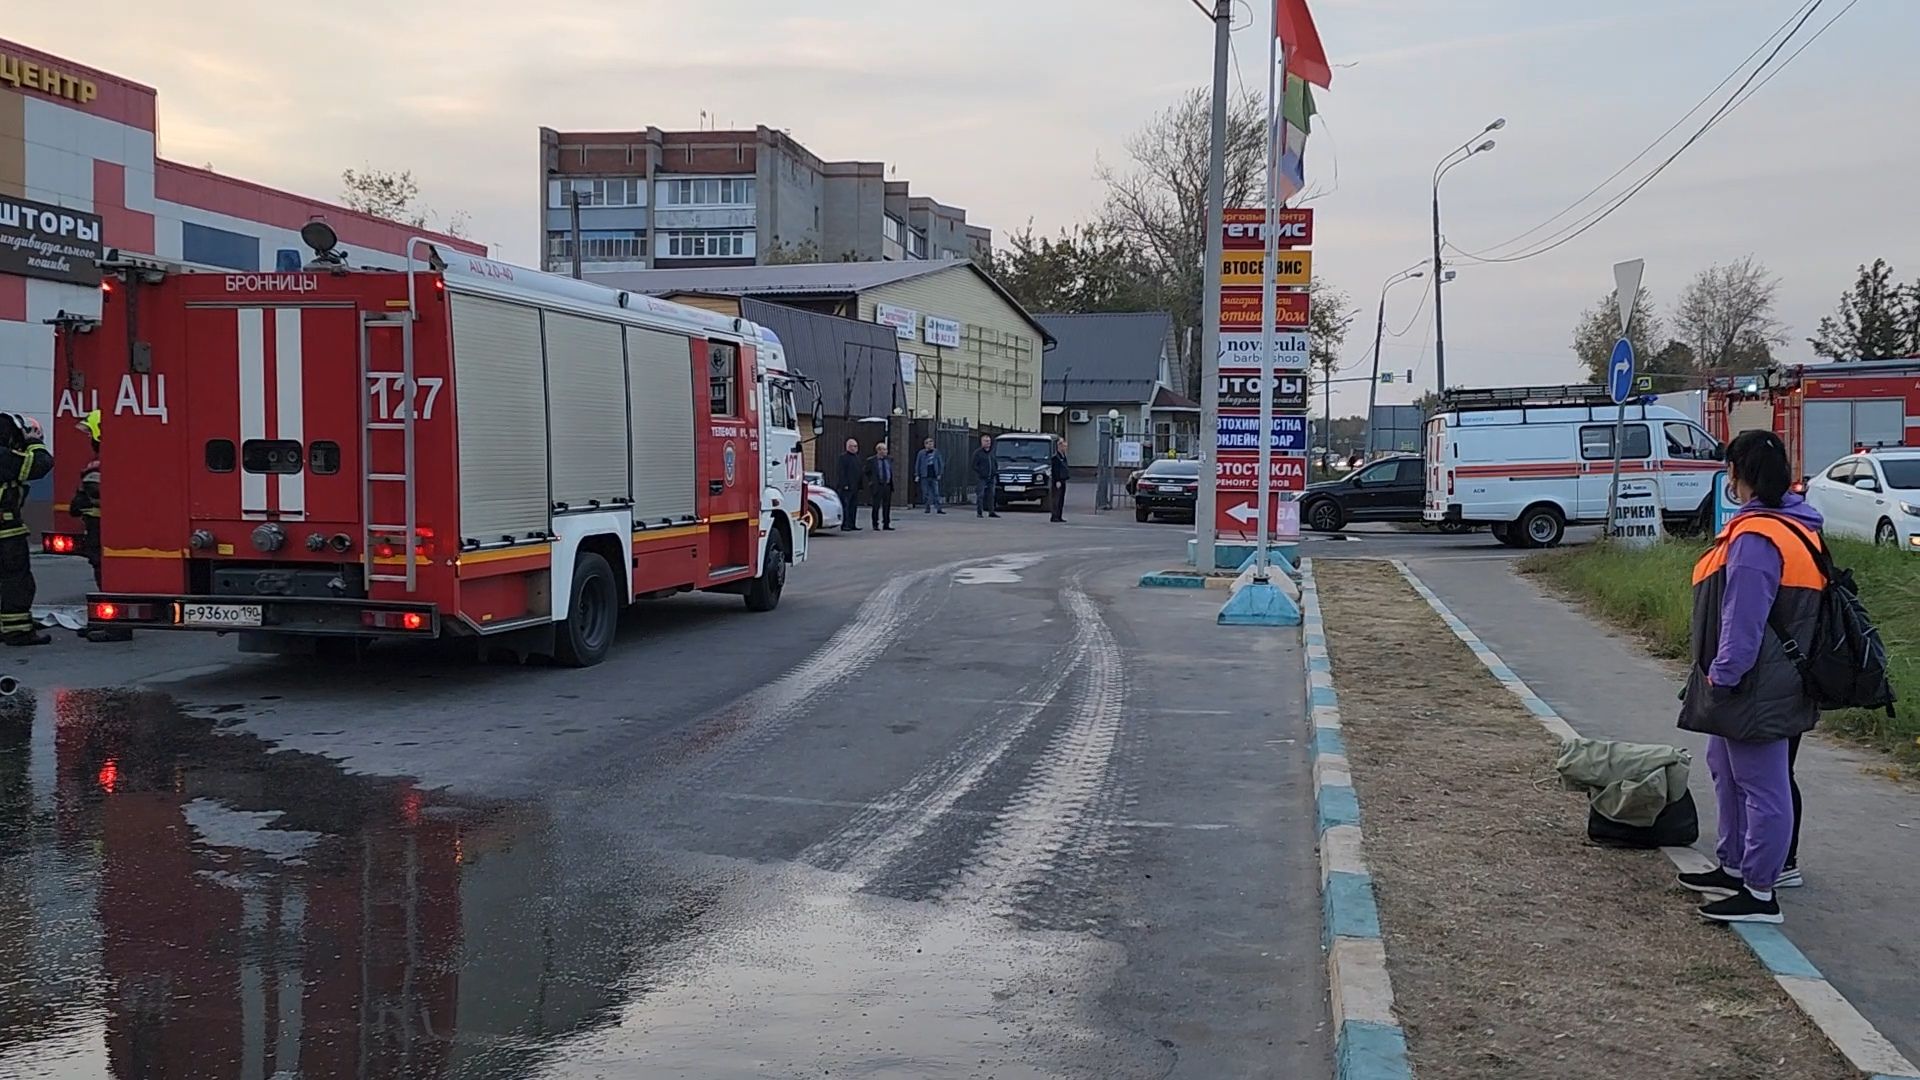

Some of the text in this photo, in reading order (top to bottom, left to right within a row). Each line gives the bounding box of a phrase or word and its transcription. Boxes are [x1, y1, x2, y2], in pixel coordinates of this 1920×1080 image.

[0, 53, 97, 103] ЦЕНТР
[0, 202, 99, 242] ШТОРЫ
[27, 256, 71, 272] пошива
[1220, 260, 1302, 275] ВТОСЕВИС
[225, 275, 318, 295] БРОННИЦЫ
[1227, 336, 1307, 351] novcula
[114, 373, 168, 424] АЦ
[370, 377, 443, 420] 127
[1615, 505, 1656, 520] ПРИЕМ
[241, 606, 259, 618] 190
